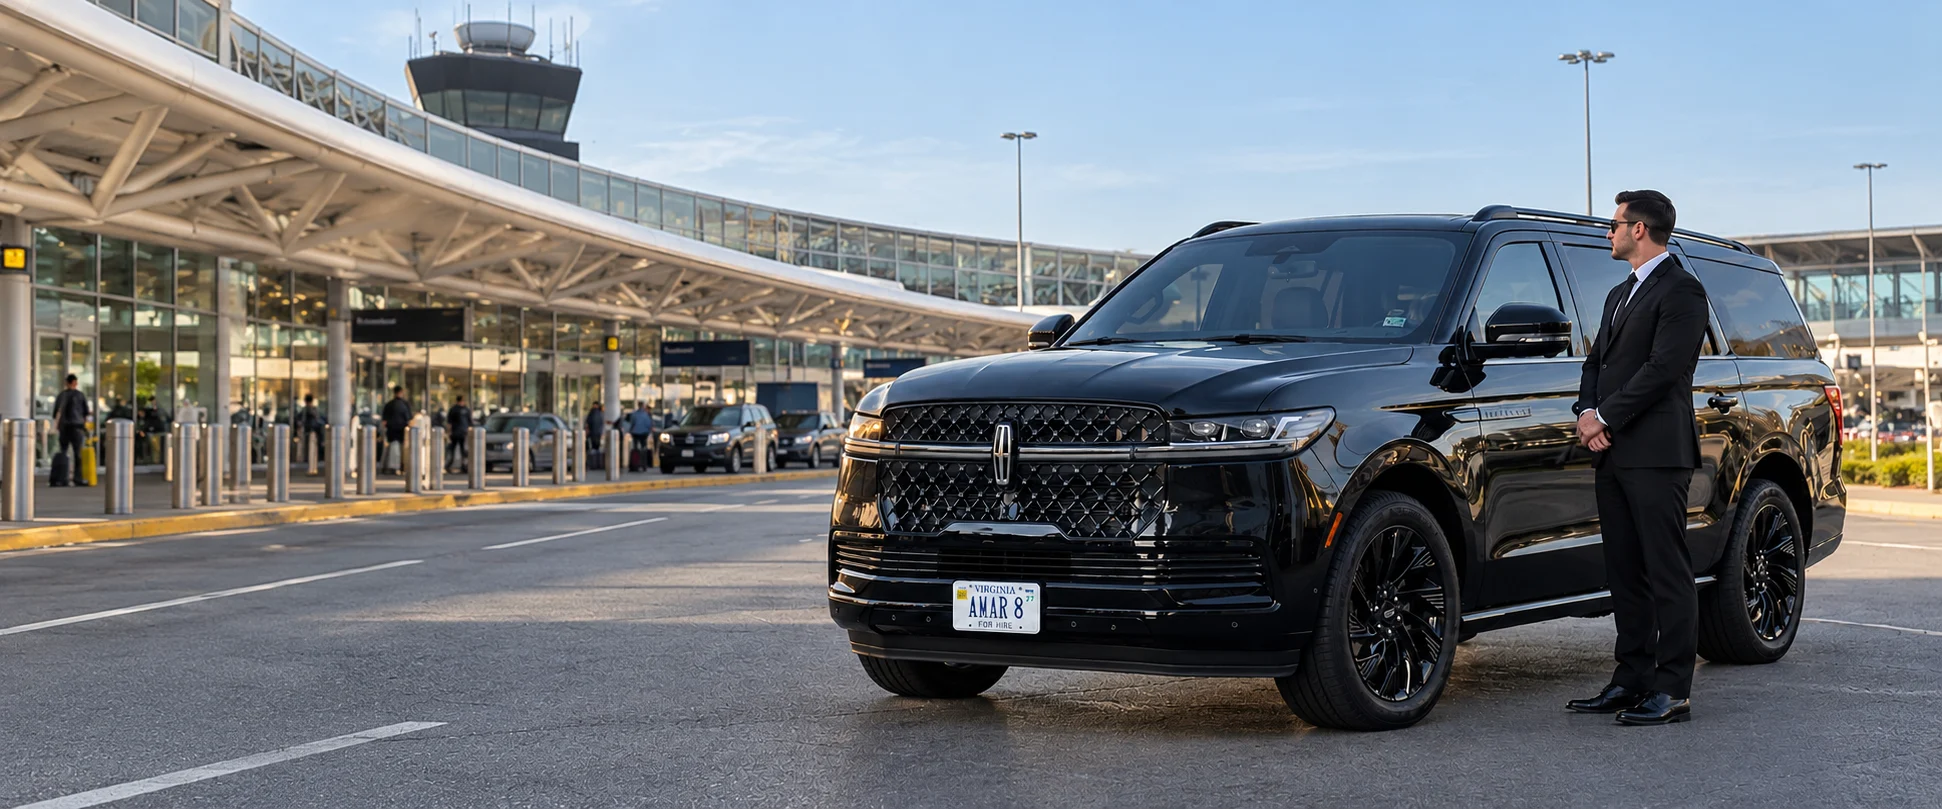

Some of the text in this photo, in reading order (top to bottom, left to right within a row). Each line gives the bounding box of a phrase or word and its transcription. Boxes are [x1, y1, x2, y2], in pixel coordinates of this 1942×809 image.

[975, 585, 1016, 594] VIRGINIA
[969, 596, 1023, 619] AMAR 8
